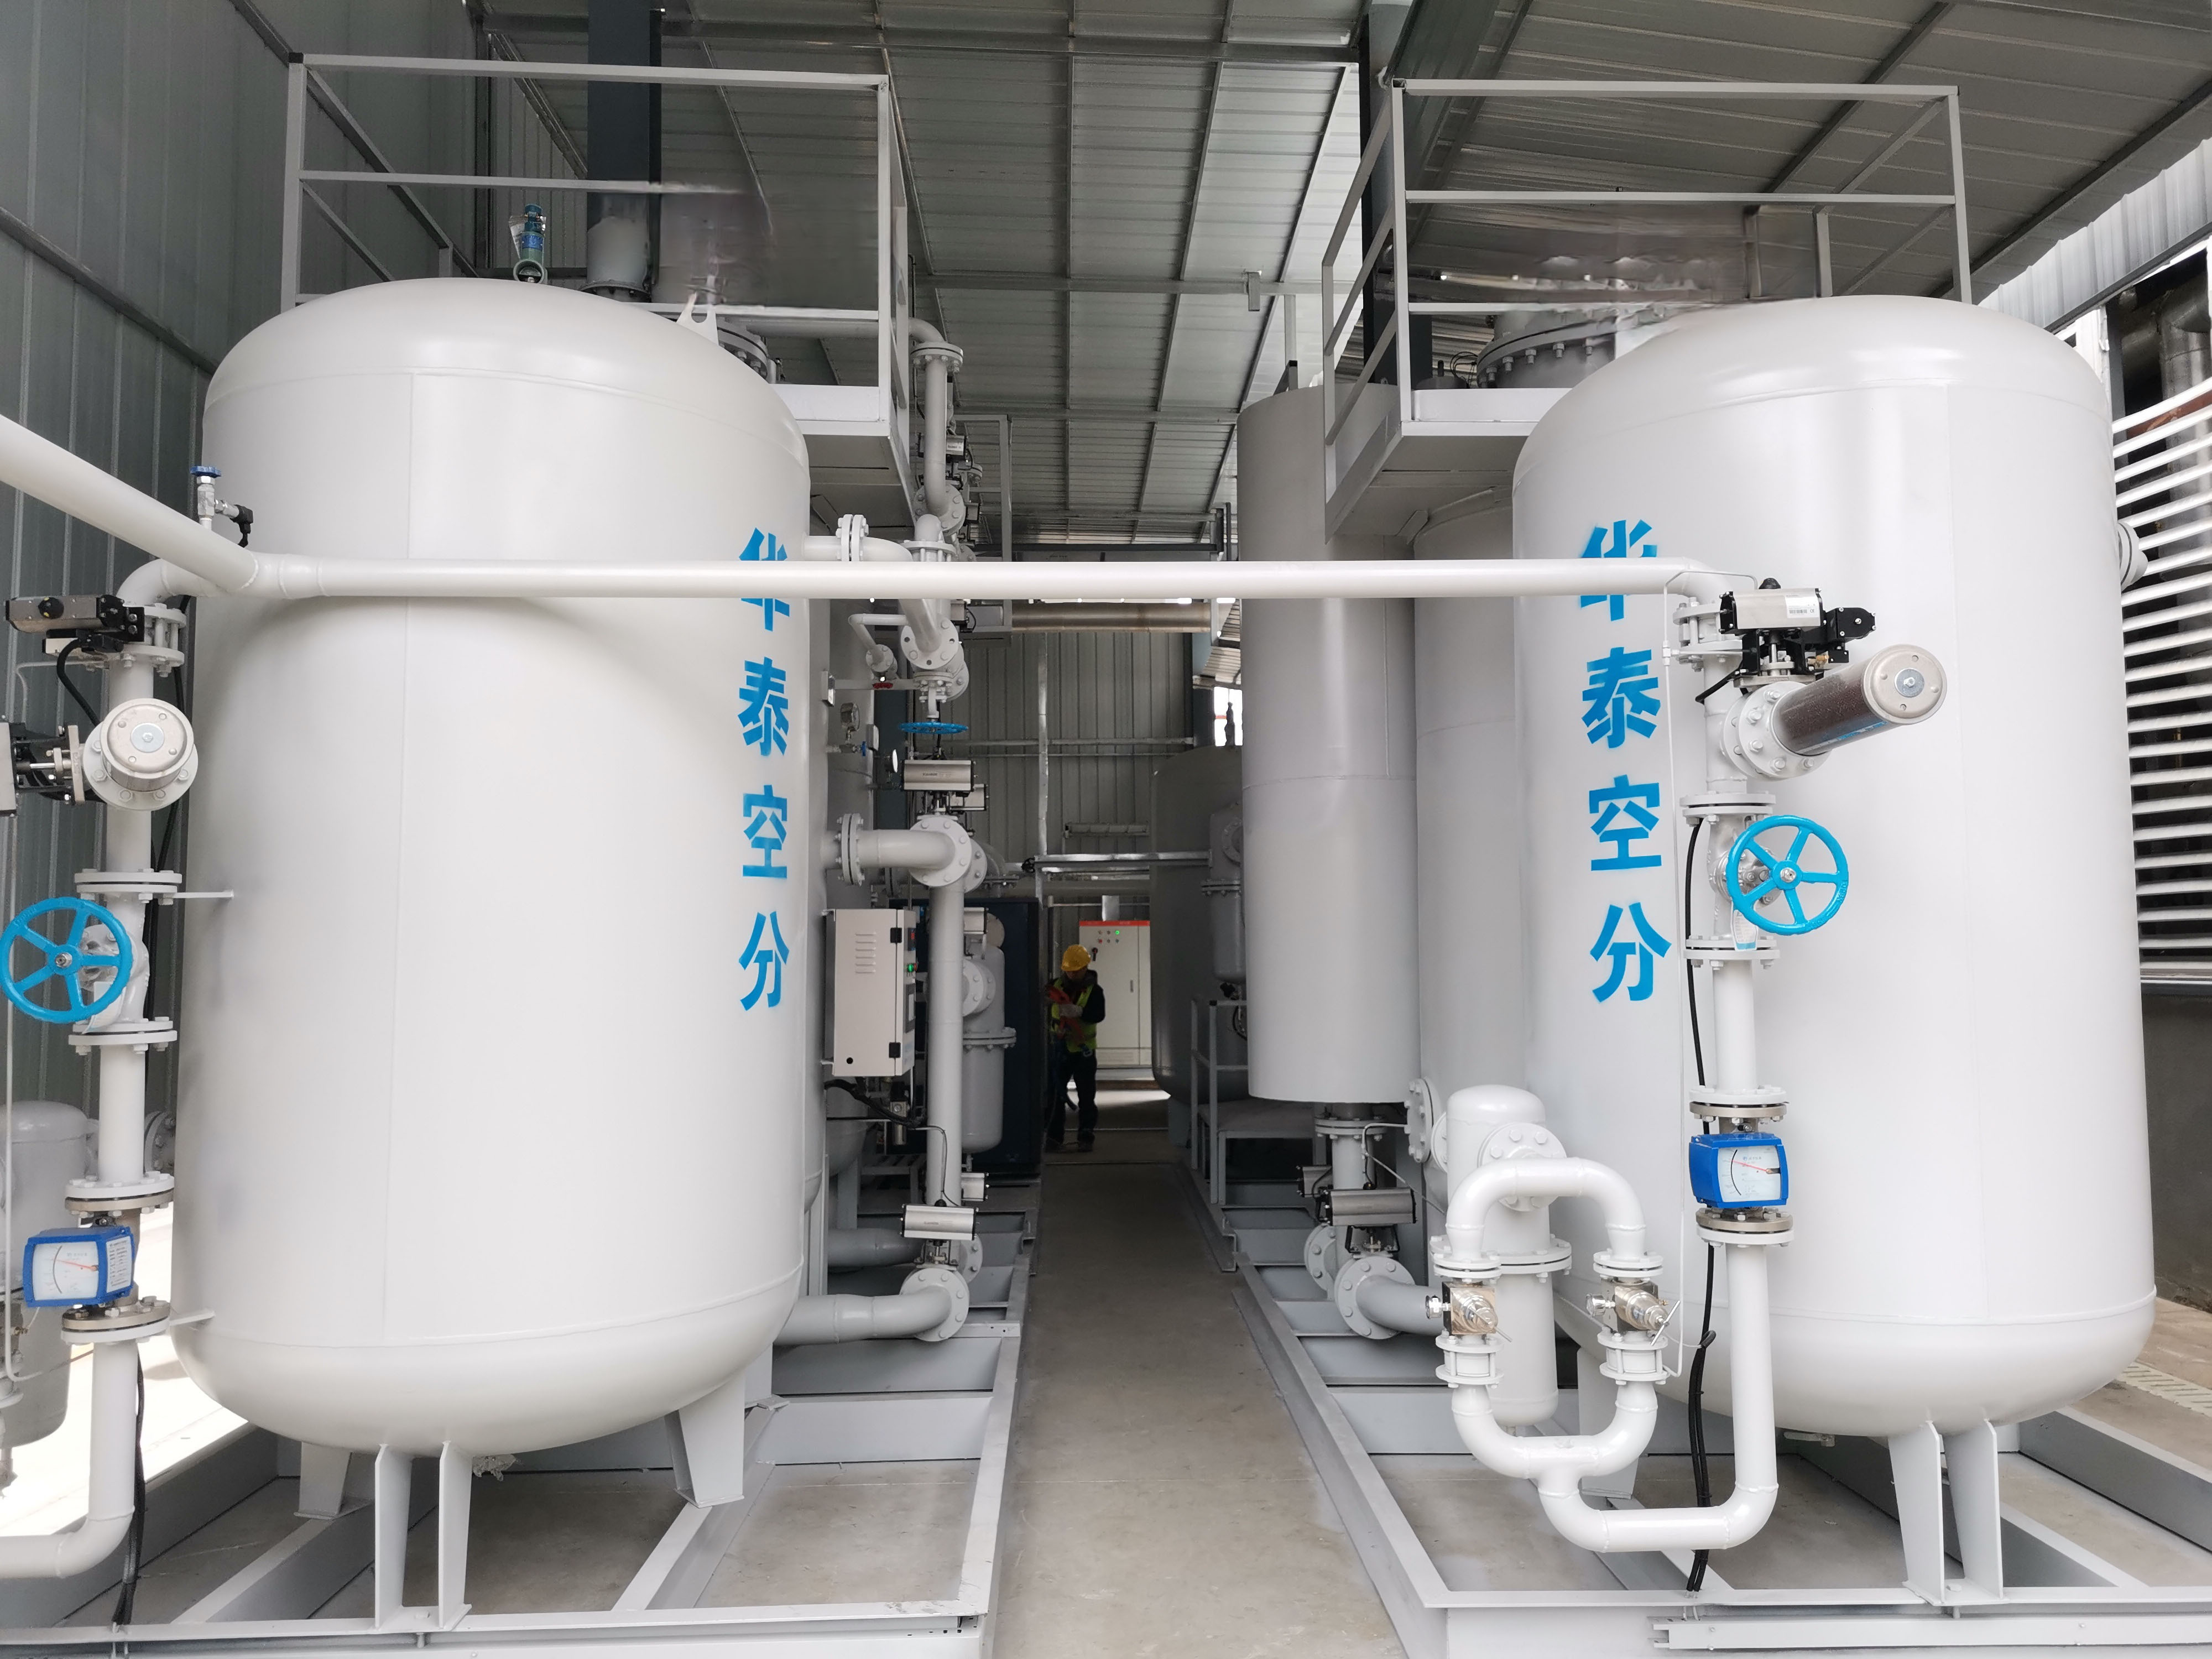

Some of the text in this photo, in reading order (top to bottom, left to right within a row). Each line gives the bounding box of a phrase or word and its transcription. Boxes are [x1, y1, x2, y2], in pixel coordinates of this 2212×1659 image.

[738, 528, 790, 1011] 华泰空分
[1579, 519, 1672, 1004] 华泰空分
